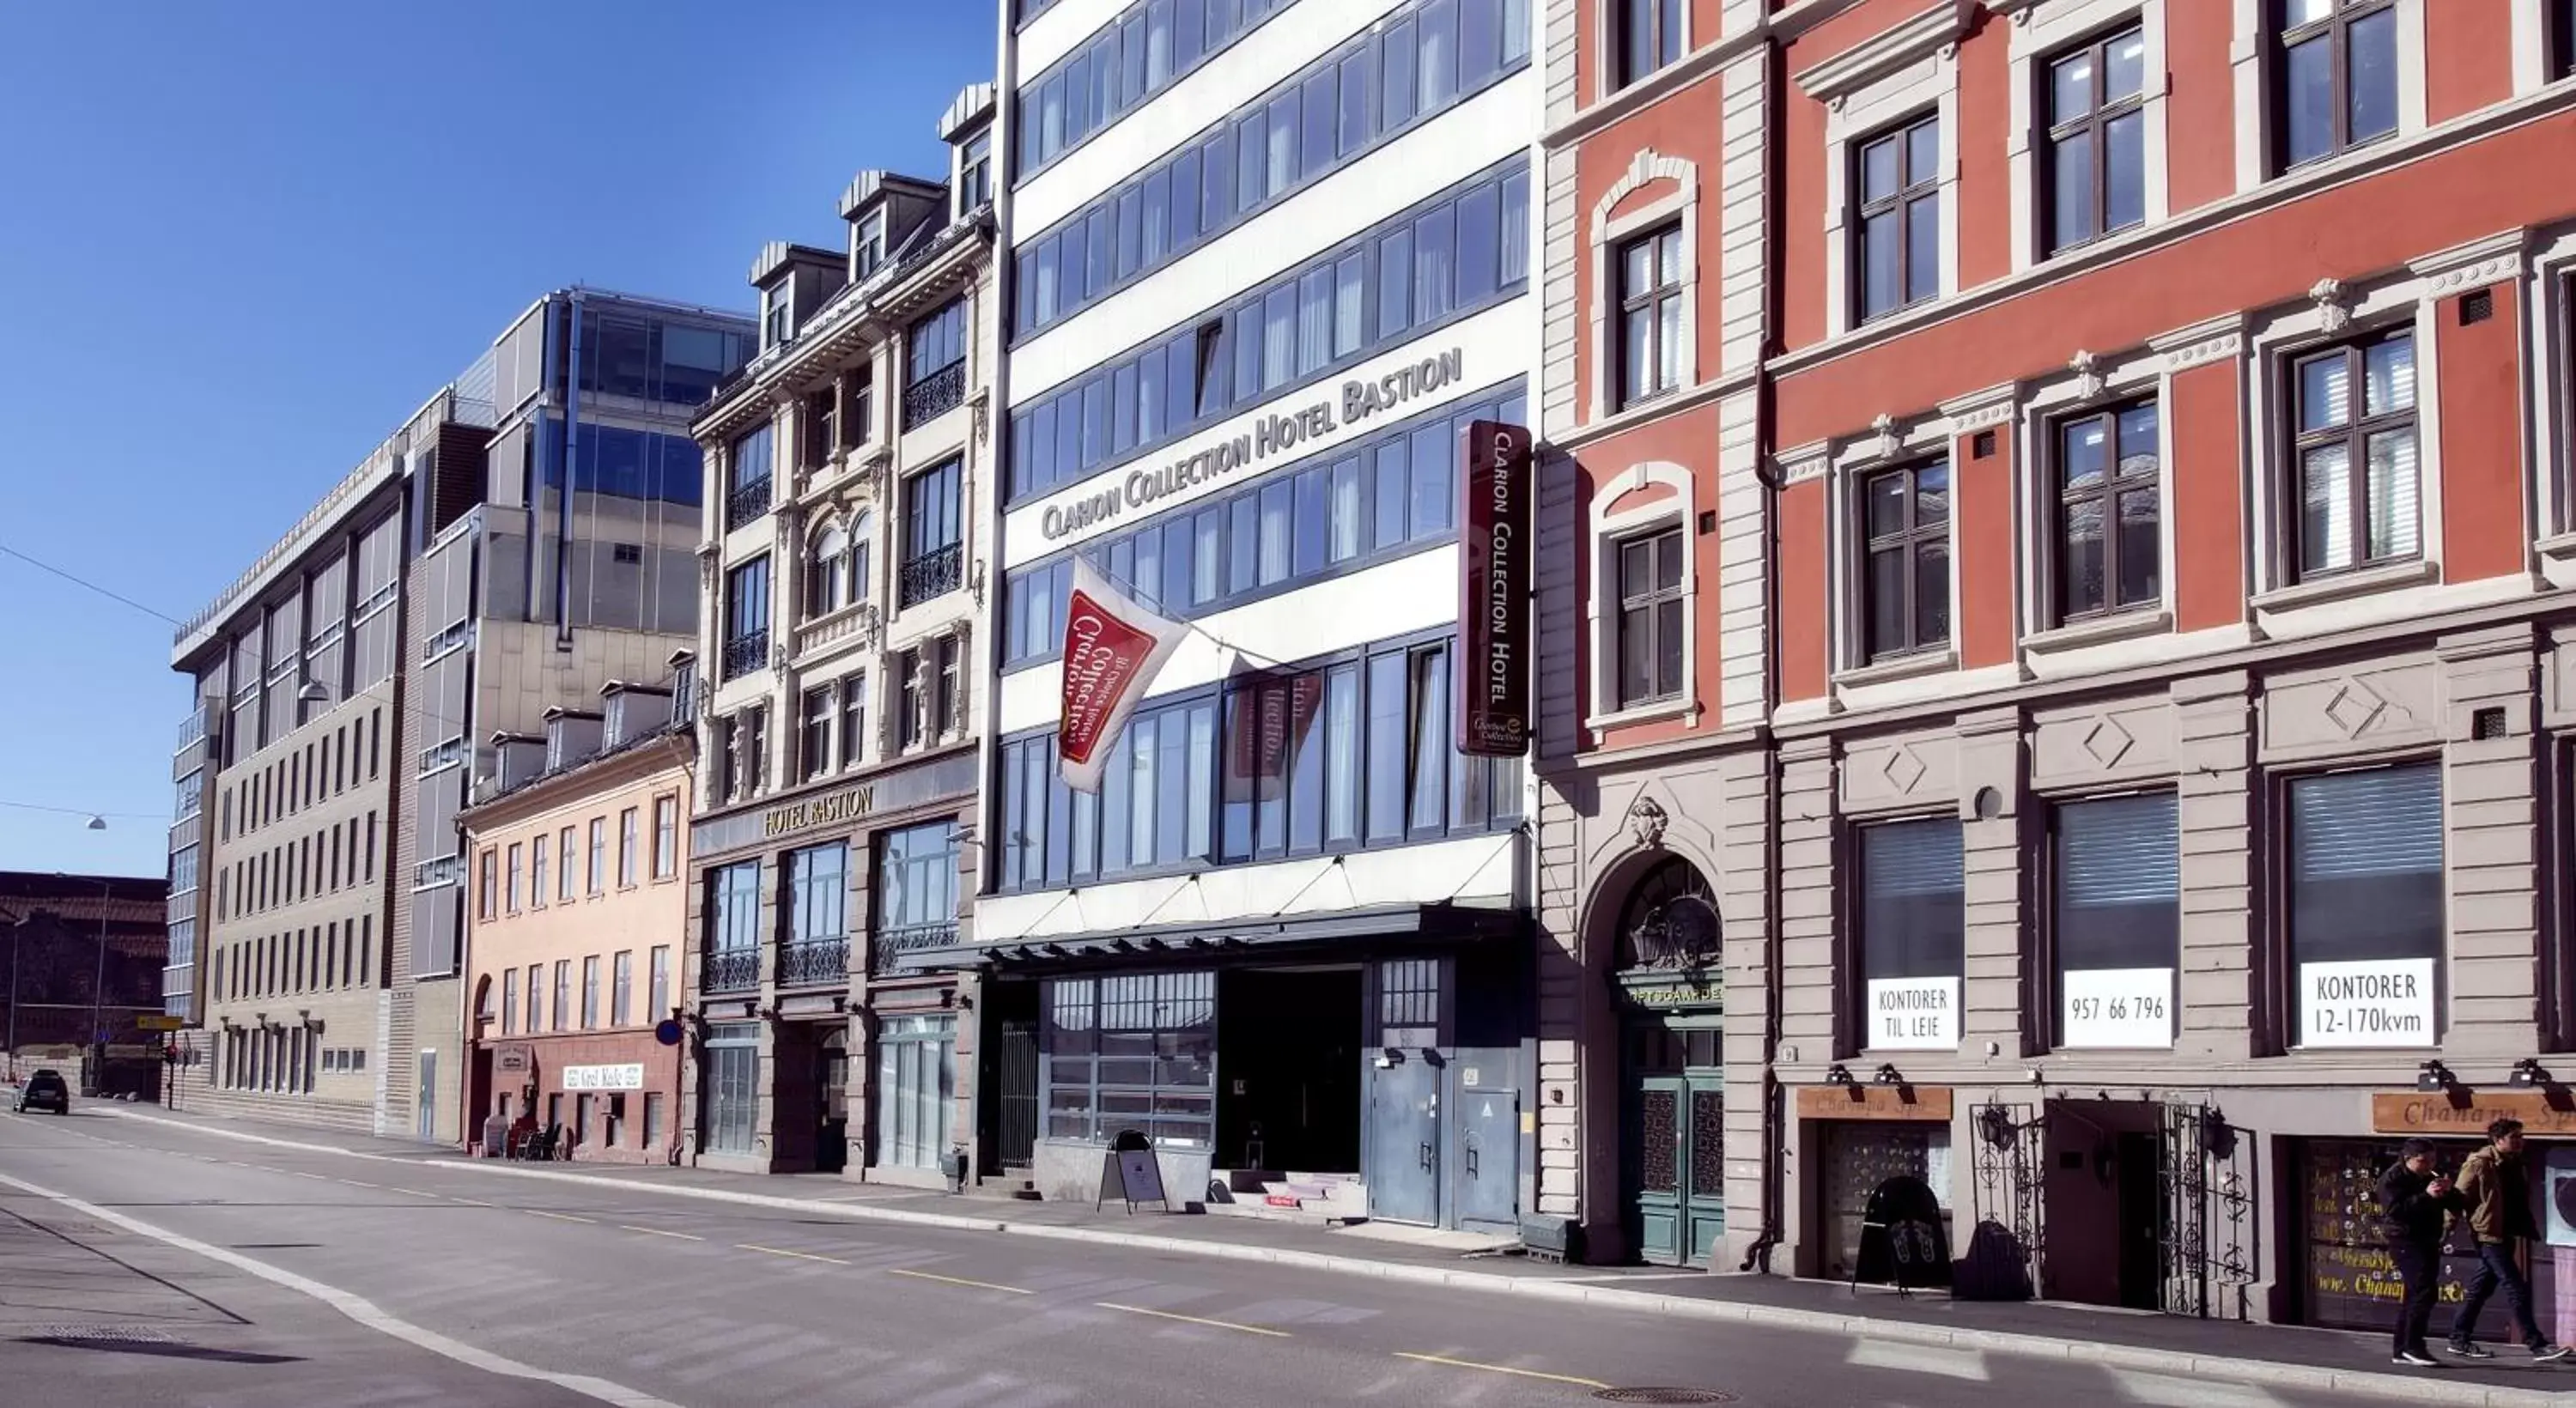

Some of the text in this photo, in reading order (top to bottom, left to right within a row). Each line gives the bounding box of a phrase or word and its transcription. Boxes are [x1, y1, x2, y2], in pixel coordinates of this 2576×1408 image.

[1042, 347, 1462, 540] CLARION COLLECTION HOTEL BASTION
[1492, 432, 1512, 704] CLARION COLLECTION HOTEL
[765, 786, 874, 836] HOTEL BASTION
[1880, 988, 1947, 1010] KONTORER
[2317, 974, 2417, 1000] KONTORER
[2072, 996, 2163, 1020] 957 66 796
[2316, 1007, 2421, 1033] 12-170kvm
[1886, 1017, 1940, 1037] TIL LEIE
